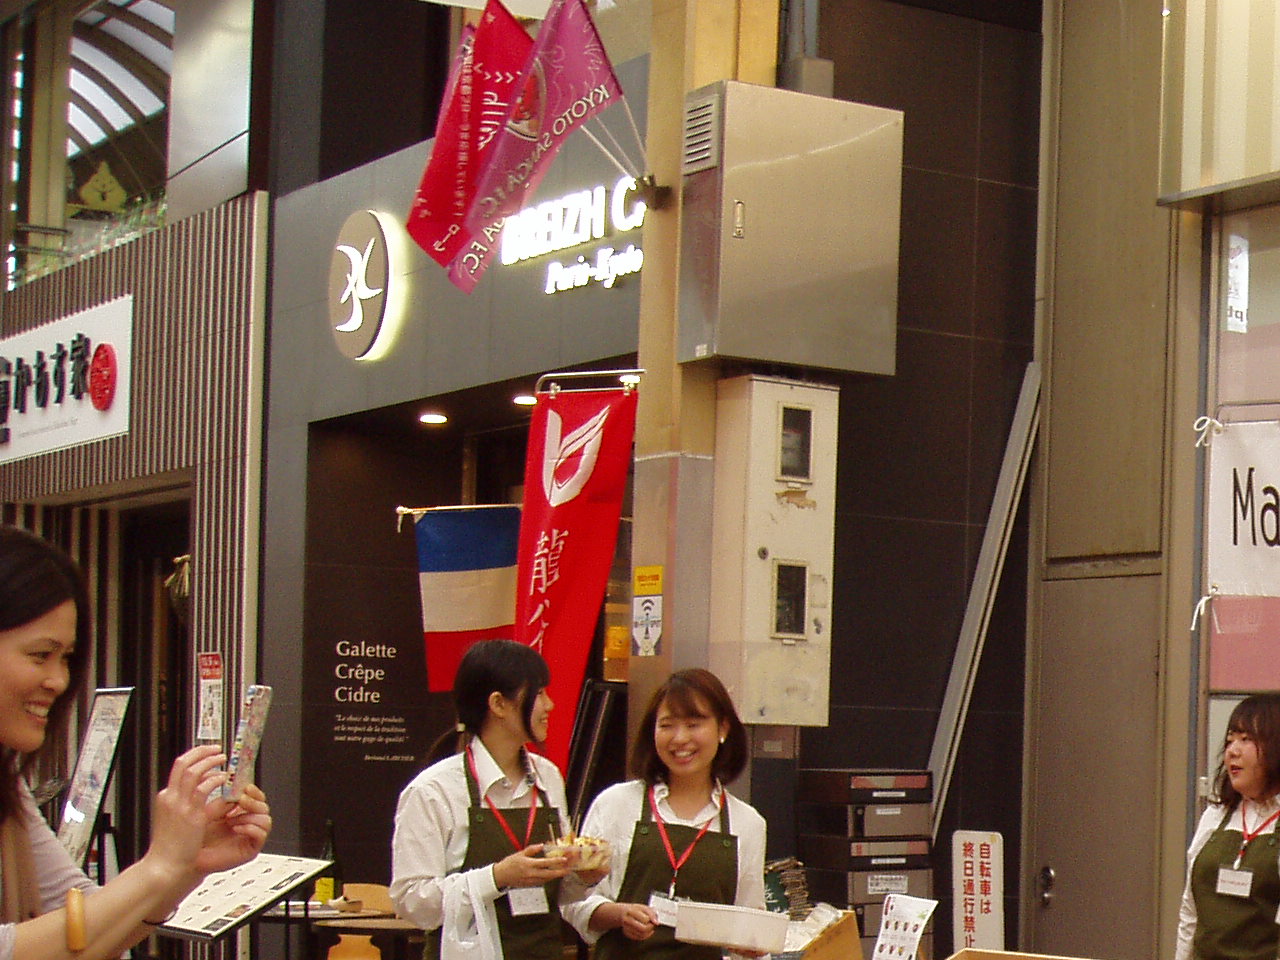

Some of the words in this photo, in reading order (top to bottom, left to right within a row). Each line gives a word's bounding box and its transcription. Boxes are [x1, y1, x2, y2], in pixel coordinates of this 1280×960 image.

[336, 641, 397, 658] Galette
[335, 664, 385, 684] Crêpe
[335, 686, 381, 704] Cidre
[980, 842, 992, 914] 自転車は
[963, 841, 976, 948] 終日通行禁止
